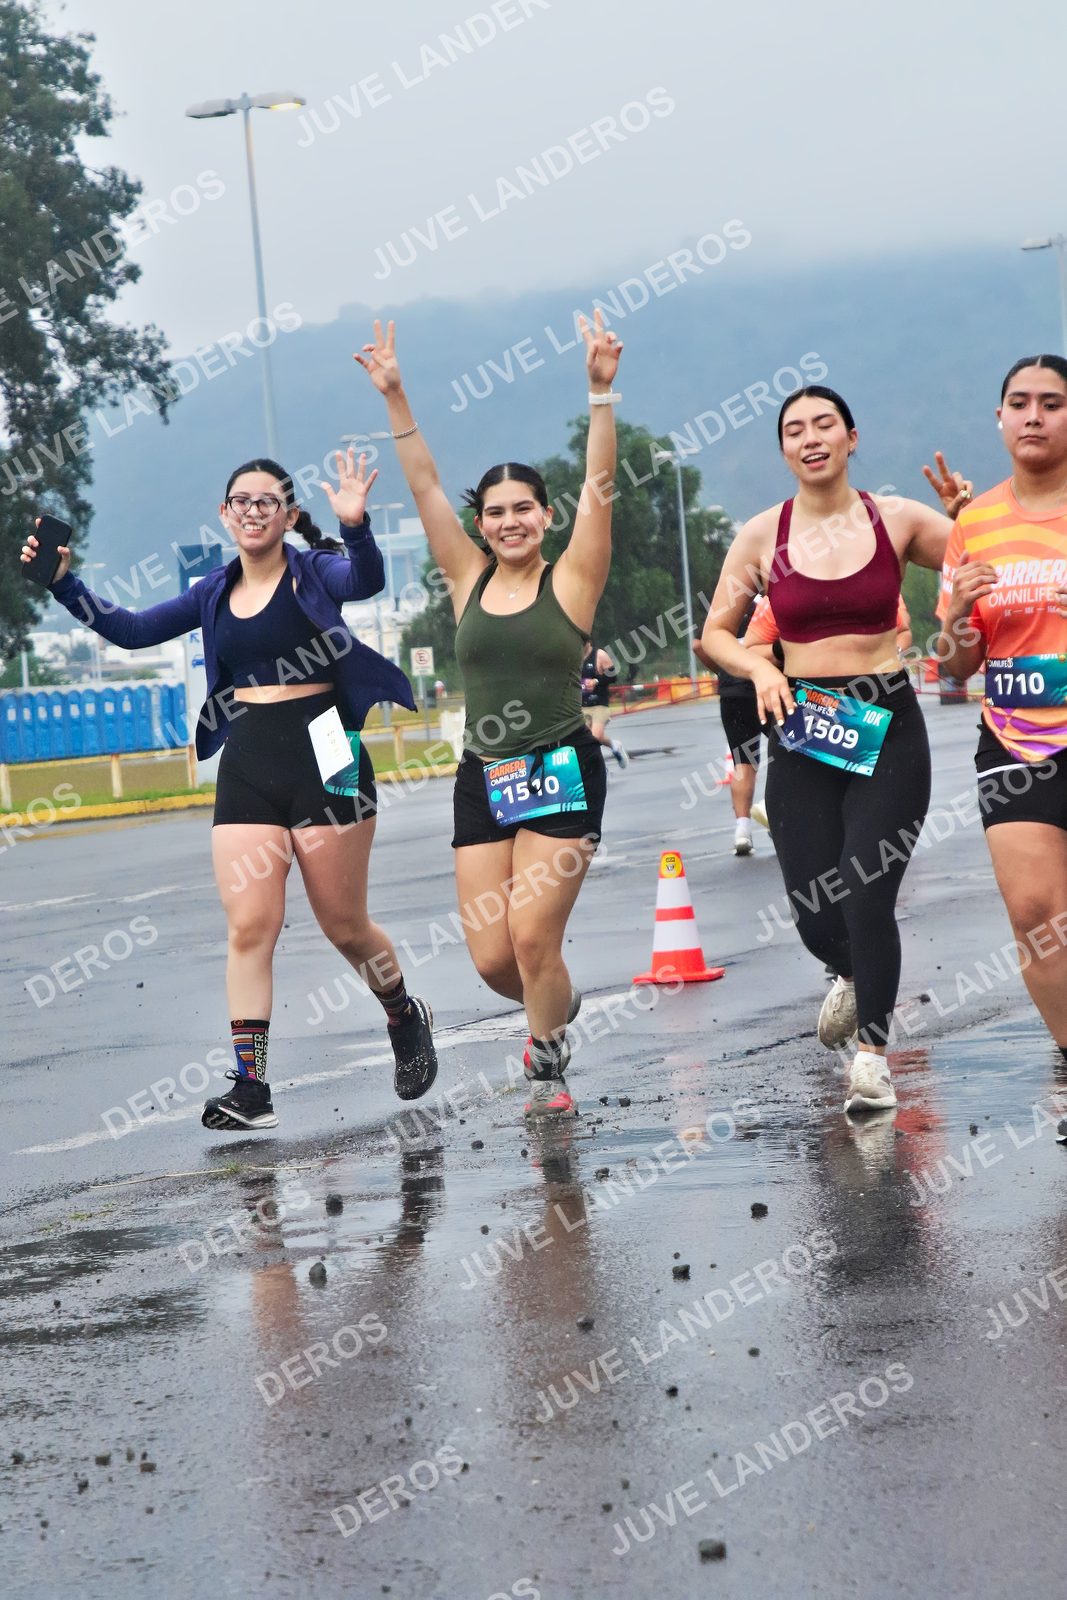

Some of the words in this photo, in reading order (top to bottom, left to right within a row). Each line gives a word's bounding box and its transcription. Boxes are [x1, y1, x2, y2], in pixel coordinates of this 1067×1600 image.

[988, 586, 1056, 609] OMNILIFE
[994, 672, 1045, 695] 1710
[802, 688, 840, 709] ARRERA
[862, 710, 885, 726] 10K
[804, 715, 859, 749] 1509
[489, 759, 526, 780] CARRERA
[551, 751, 570, 766] 10K
[502, 775, 560, 804] 1510
[253, 1033, 265, 1083] CORRER
